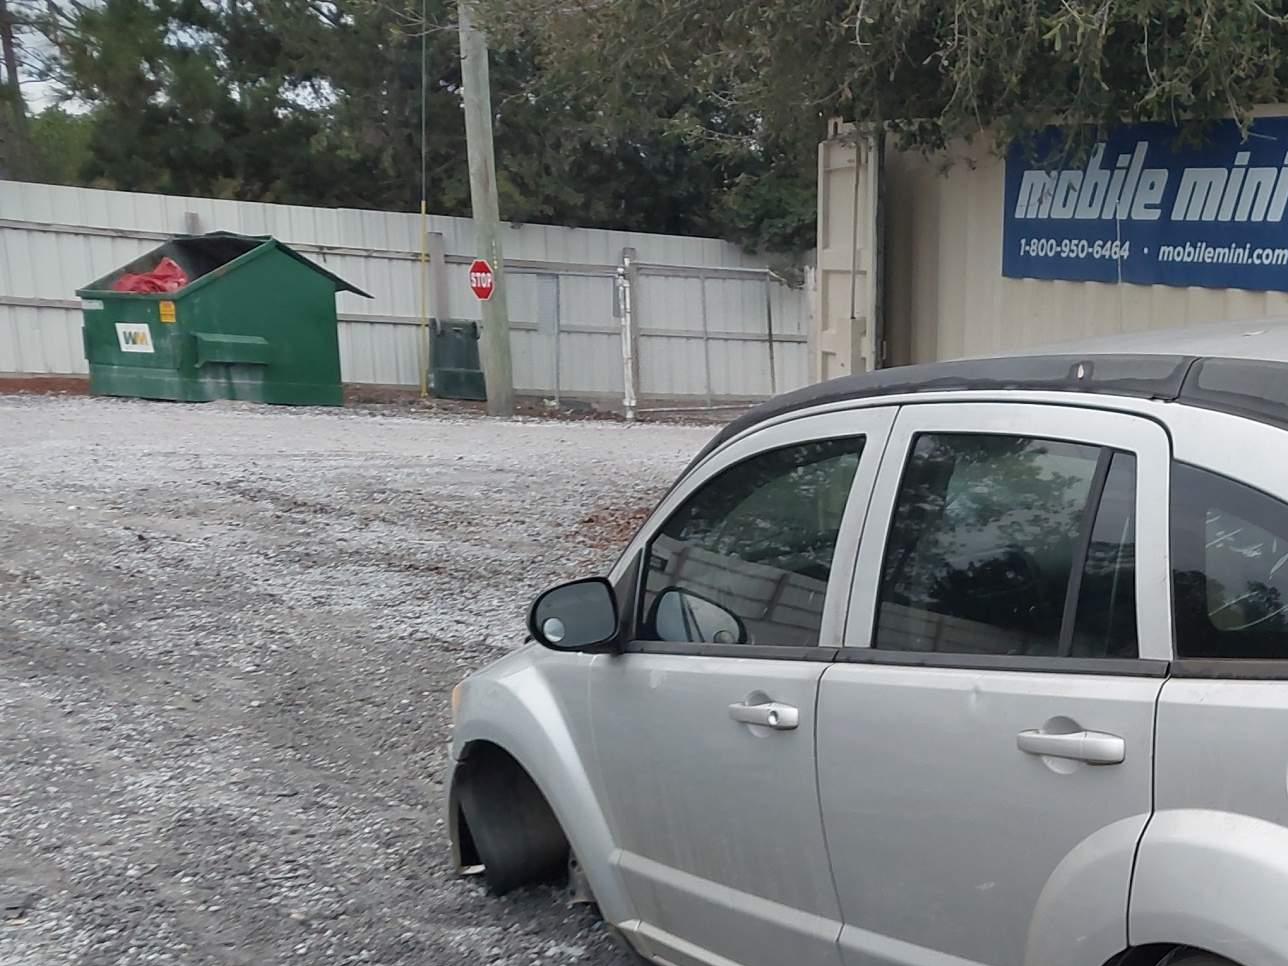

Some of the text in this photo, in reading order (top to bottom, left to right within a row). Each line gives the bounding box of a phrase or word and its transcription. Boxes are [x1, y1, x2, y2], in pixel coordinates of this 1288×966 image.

[1014, 141, 1169, 221] mobile
[1018, 239, 1130, 260] 1-800-950-6464
[470, 271, 493, 288] STOP
